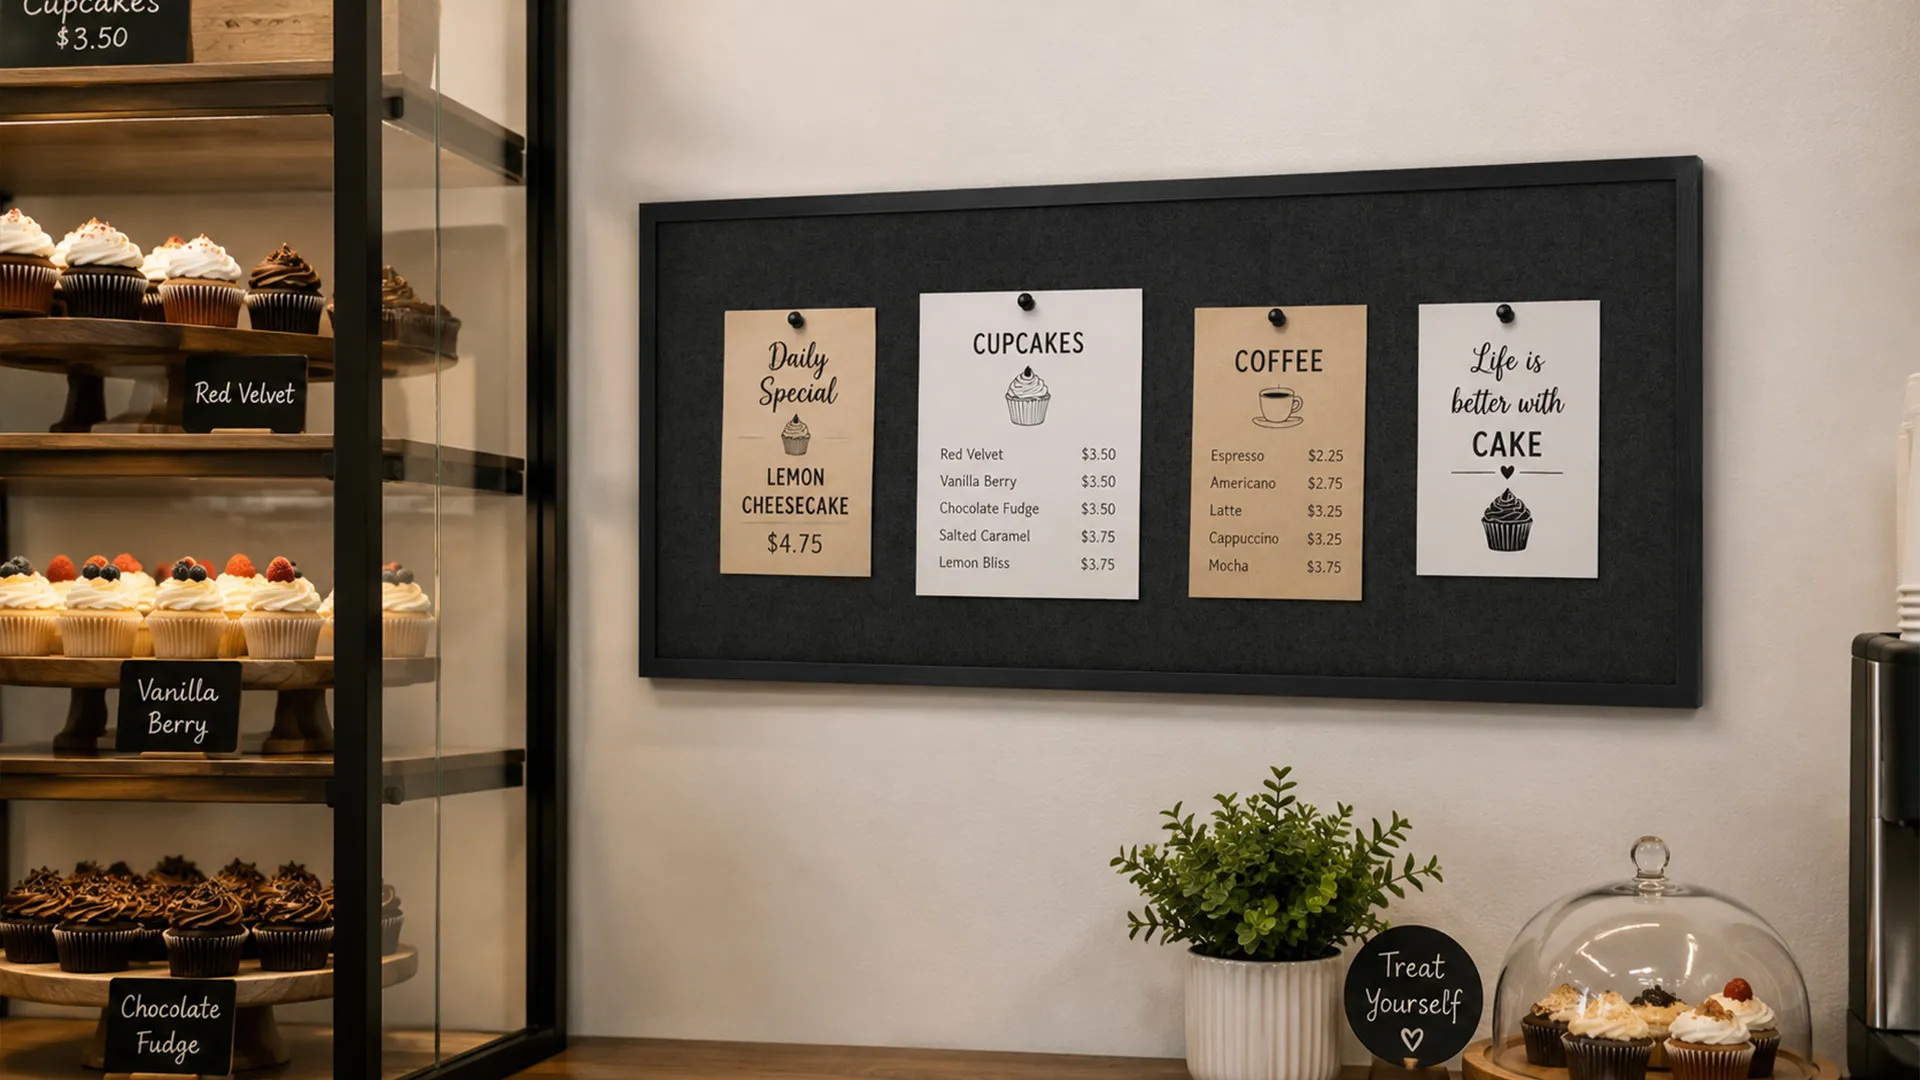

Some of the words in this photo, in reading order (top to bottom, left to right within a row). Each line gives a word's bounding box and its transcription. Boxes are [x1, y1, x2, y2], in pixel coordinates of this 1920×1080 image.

[57, 27, 127, 50] $3.50
[974, 332, 1083, 354] CUPCAKES
[768, 341, 829, 380] Daily
[1236, 350, 1322, 372] COFFEE
[1471, 342, 1518, 381] Life
[1527, 352, 1545, 373] is
[195, 381, 231, 403] Red
[239, 382, 295, 403] Velvet
[760, 375, 838, 412] Special
[1452, 387, 1511, 414] better
[1519, 387, 1565, 414] with
[941, 448, 962, 460] Red
[967, 448, 1003, 460] Velvet
[1082, 447, 1116, 461] $3.50
[1473, 431, 1541, 457] CAKE
[1212, 449, 1264, 464] Espresso
[1309, 449, 1343, 462] $2.25
[768, 468, 824, 485] LEMON
[940, 475, 979, 487] Vanilla
[985, 475, 1016, 490] Berry
[1082, 475, 1116, 488] $3.50
[1210, 476, 1276, 489] Americano
[1308, 477, 1342, 490] $2.75
[743, 496, 848, 514] CHEESECAKE
[940, 502, 999, 514] Chocolate
[1004, 502, 1039, 517] Fudge
[1082, 502, 1115, 515] $3.50
[1210, 504, 1241, 516] Latte
[1308, 504, 1342, 517] $3.25
[768, 532, 822, 554] $4.75
[940, 529, 976, 541] Salted
[981, 530, 1029, 542] Caramel
[1082, 530, 1115, 543] $3.75
[1209, 531, 1279, 547] Cappuccino
[1308, 532, 1341, 545] $3.25
[940, 556, 978, 568] Lemon
[984, 557, 1009, 568] Bliss
[1081, 558, 1114, 571] $3.75
[1209, 559, 1248, 572] Mocha
[1307, 560, 1341, 573] $3.75
[138, 678, 218, 701] Vanilla
[149, 711, 208, 744] Berry
[1379, 951, 1445, 979] Treat
[122, 994, 220, 1018] Chocolate
[1366, 988, 1463, 1024] Yourself
[137, 1031, 199, 1064] Fudge
